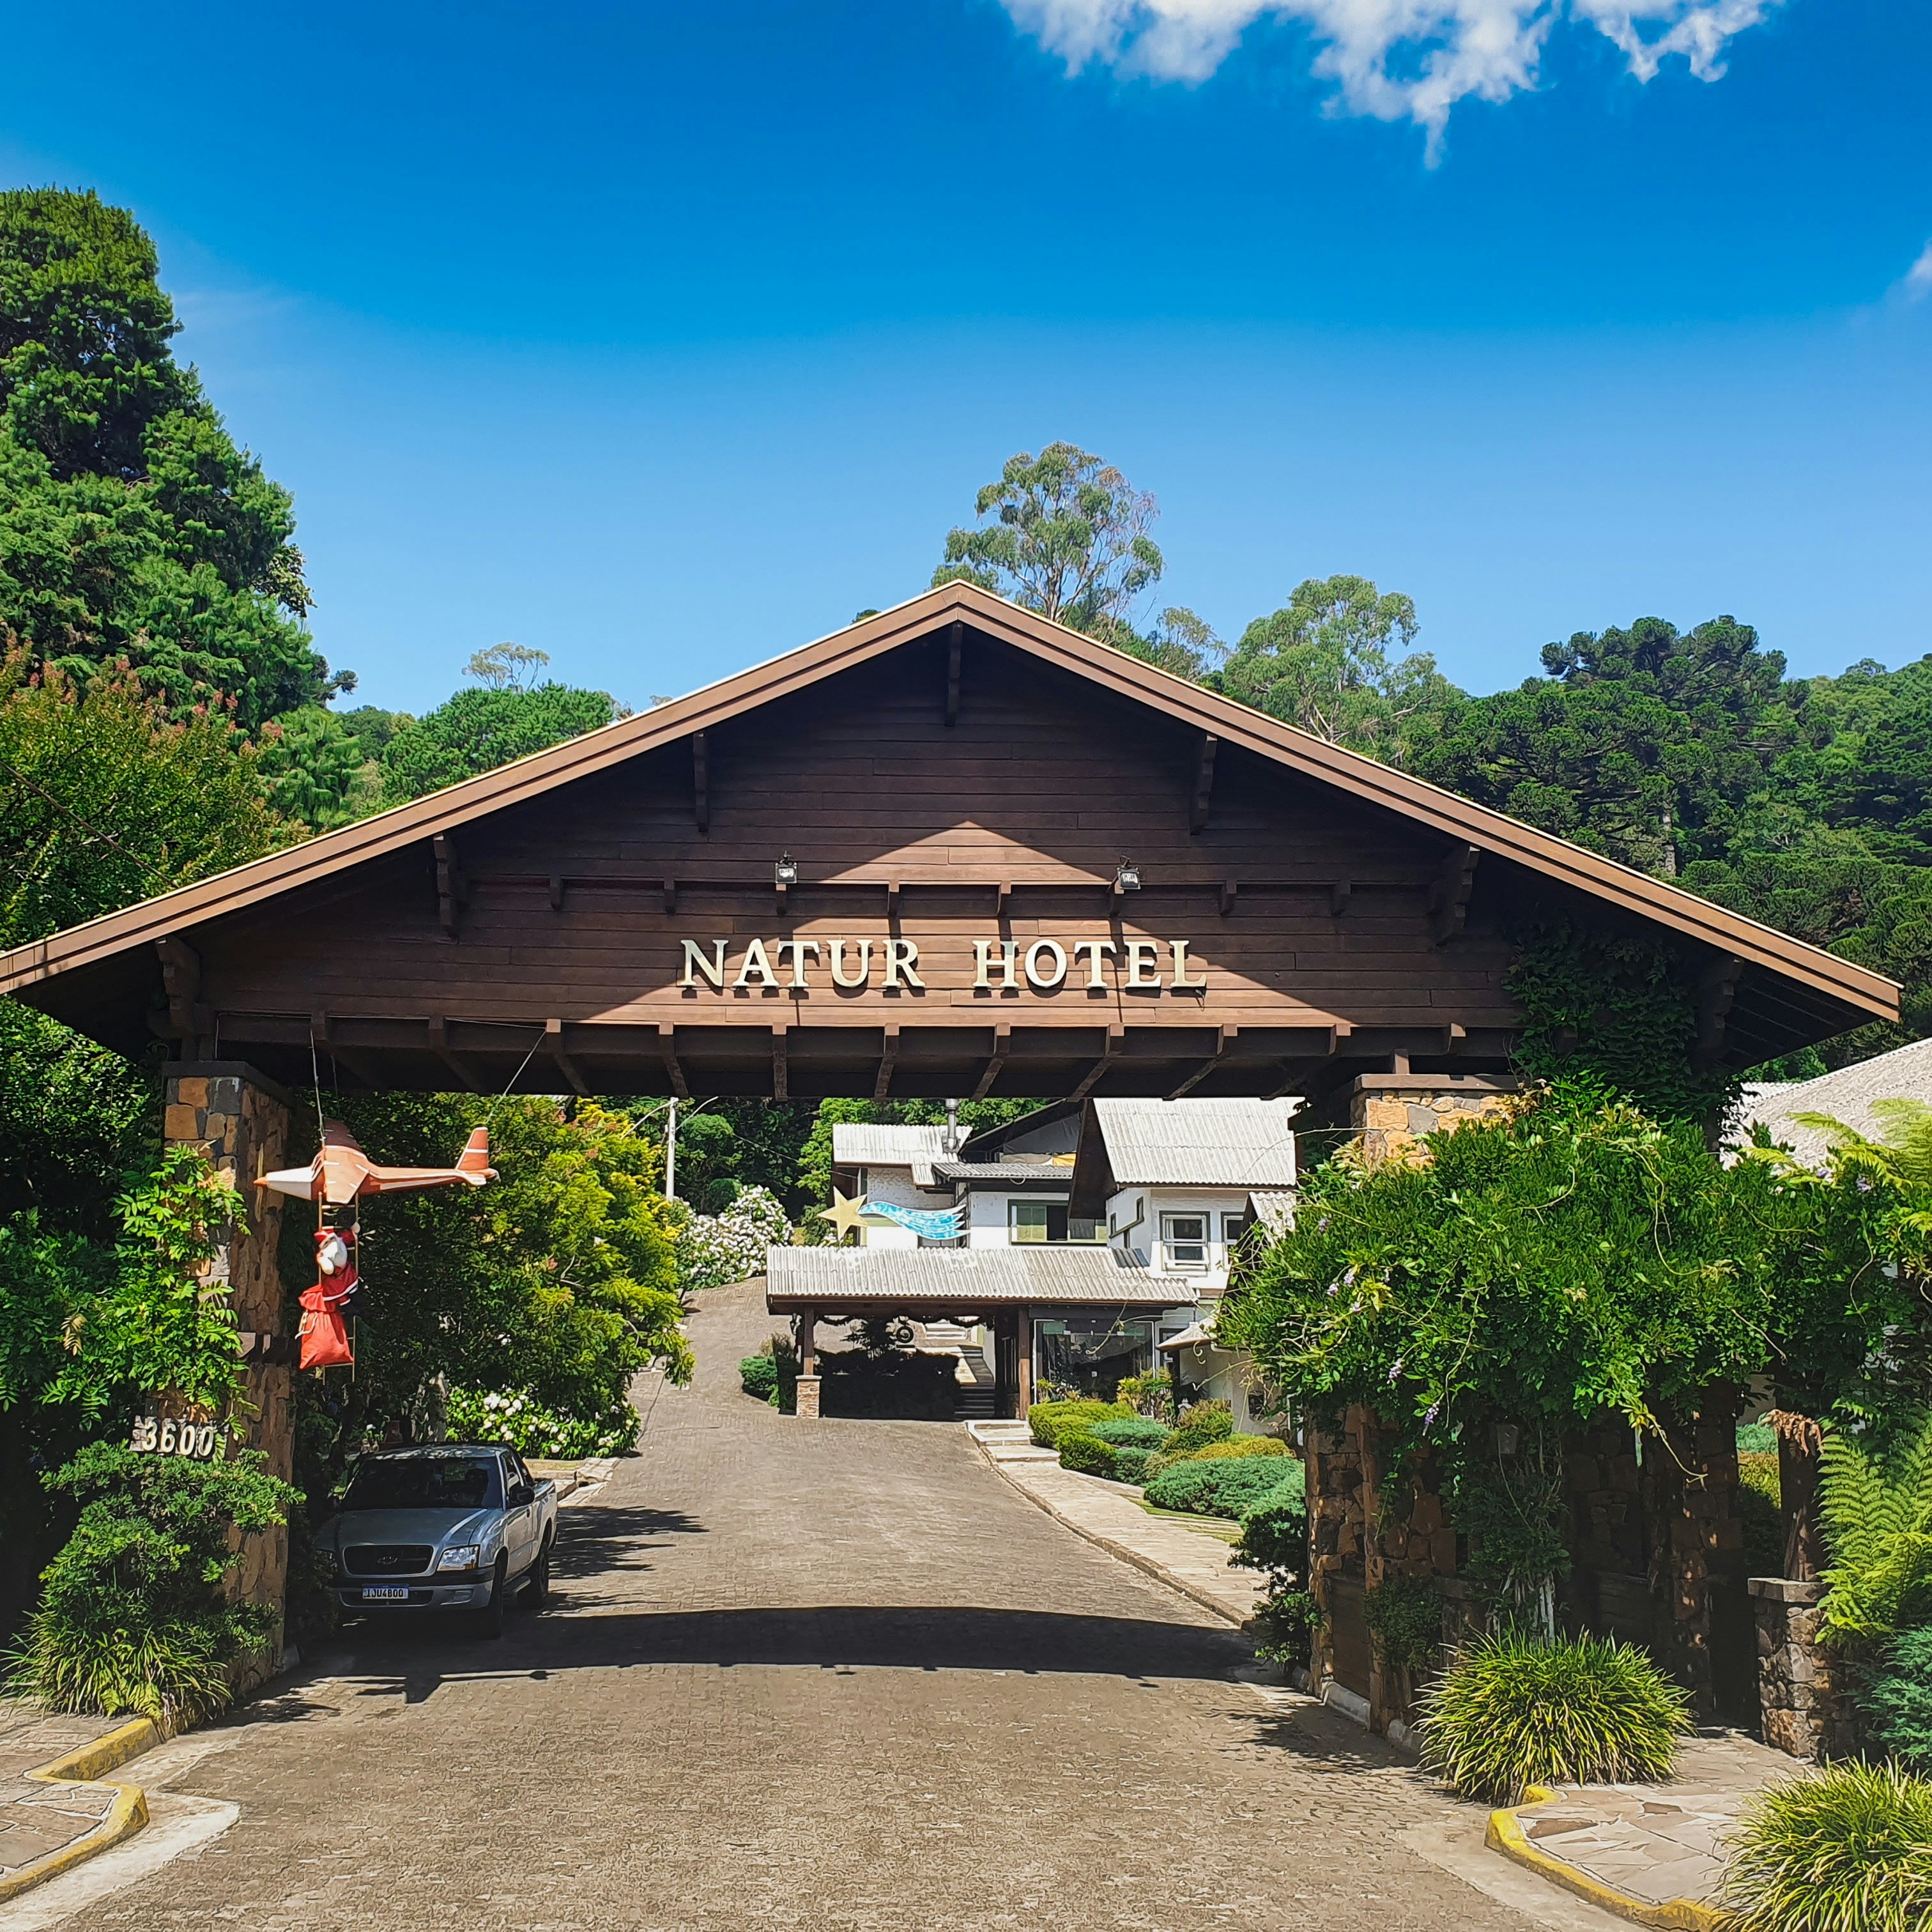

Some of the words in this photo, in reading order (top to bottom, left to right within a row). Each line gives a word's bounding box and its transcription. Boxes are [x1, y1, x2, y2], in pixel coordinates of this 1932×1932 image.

[680, 937, 926, 988] NATUR
[971, 939, 1208, 988] HOTEL
[141, 1420, 214, 1457] 3600
